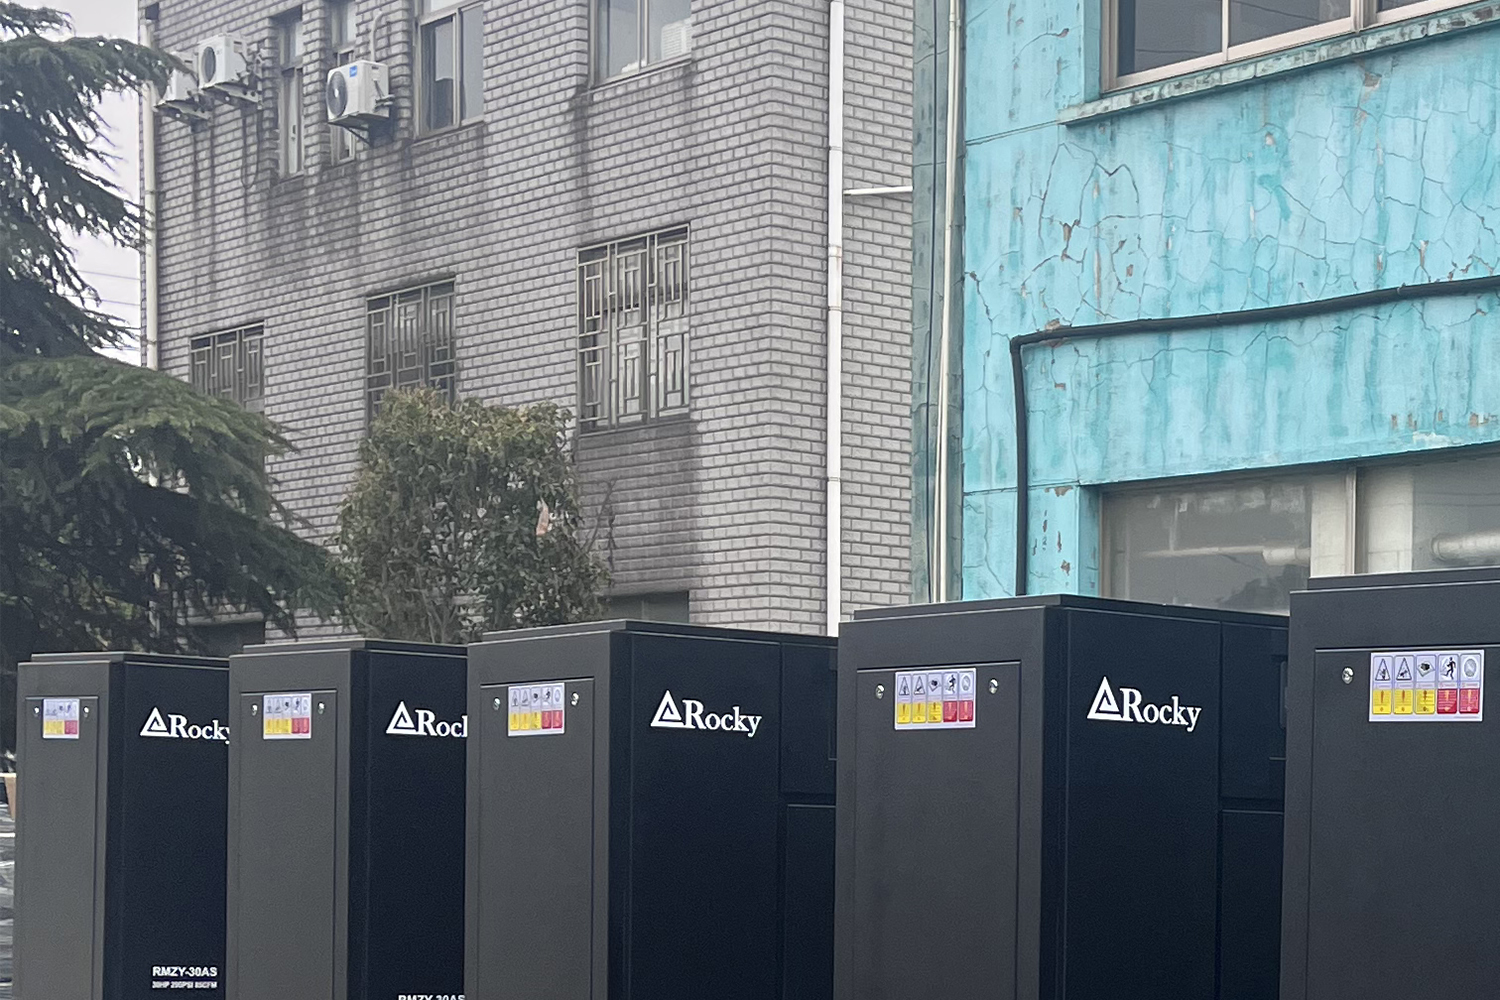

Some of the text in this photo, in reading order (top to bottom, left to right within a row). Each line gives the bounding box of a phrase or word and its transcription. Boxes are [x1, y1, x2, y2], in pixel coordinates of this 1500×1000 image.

[682, 699, 762, 738] Rocky
[1119, 687, 1202, 732] Rocky
[167, 713, 230, 745] Rock
[152, 965, 218, 977] RMZY-30AS
